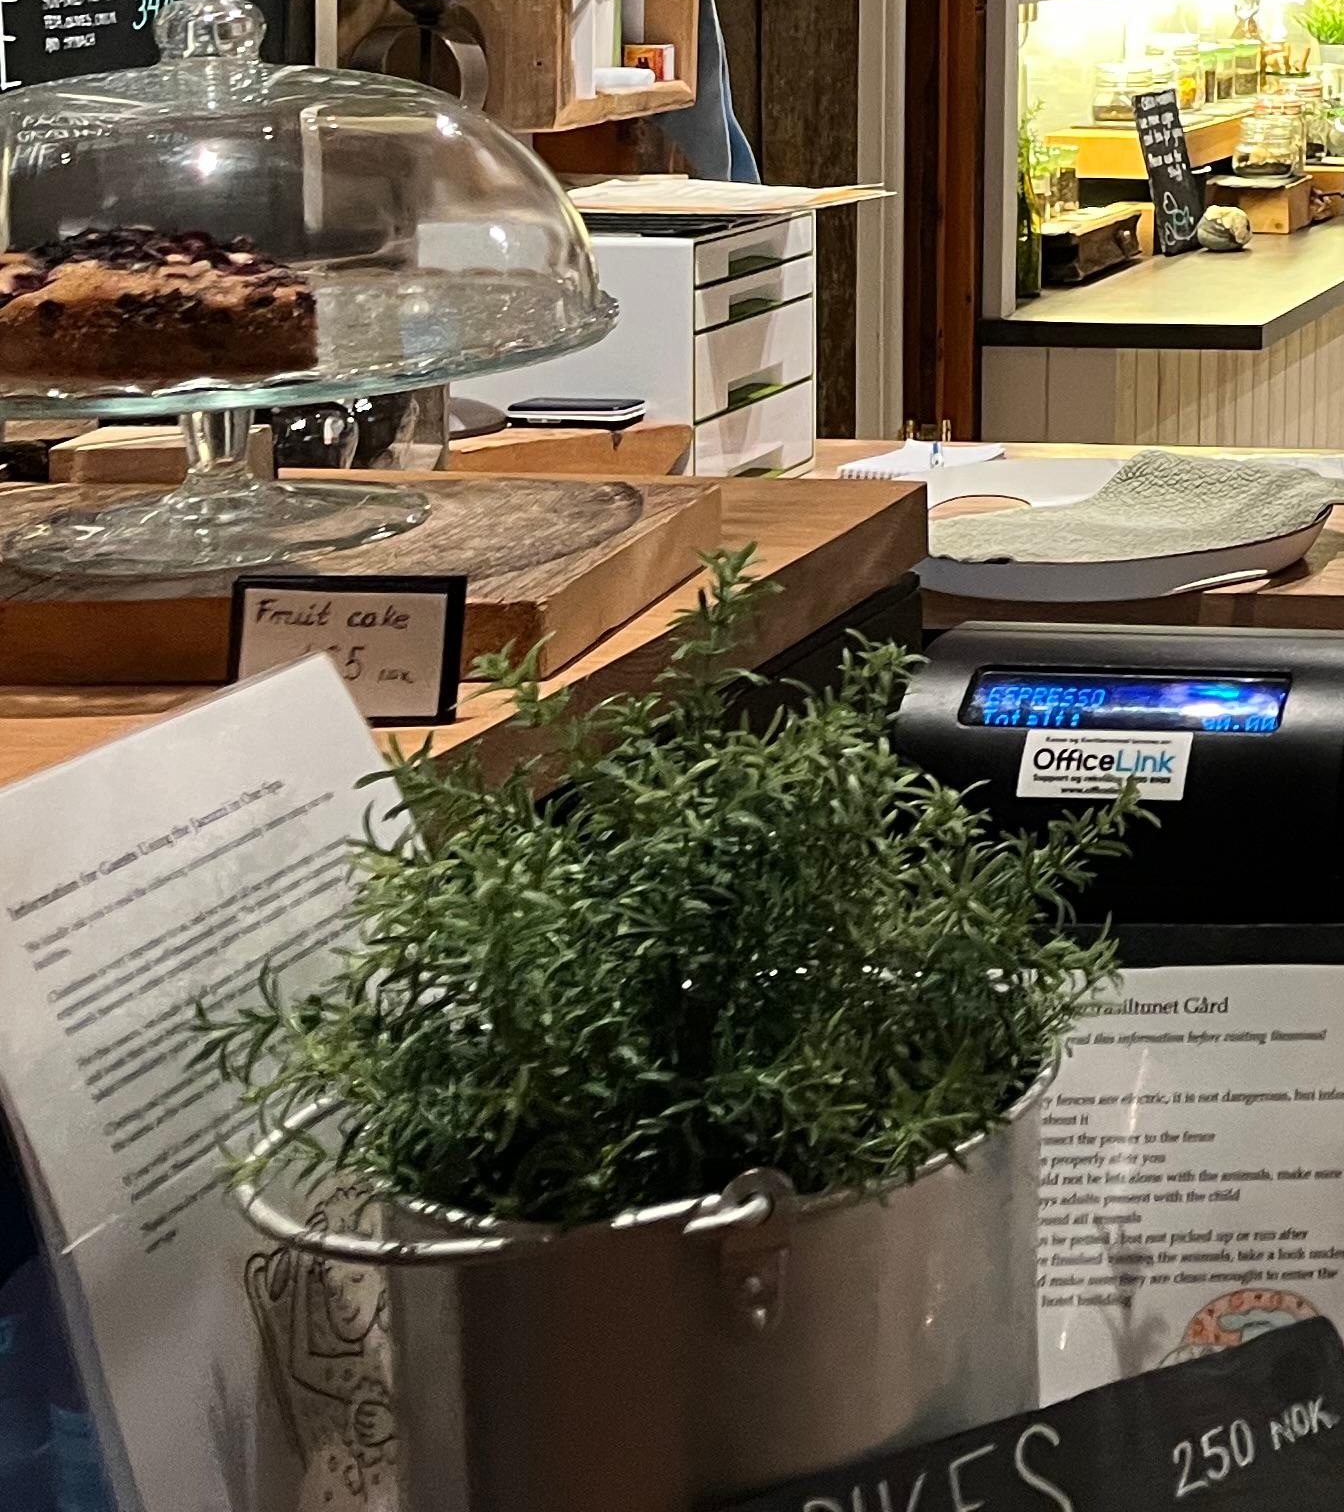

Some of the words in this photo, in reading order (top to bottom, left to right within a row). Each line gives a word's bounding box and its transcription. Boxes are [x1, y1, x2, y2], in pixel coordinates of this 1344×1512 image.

[256, 593, 332, 626] Fruit
[346, 600, 411, 630] cake
[986, 686, 1107, 709] ESPRESSO
[1033, 748, 1177, 774] OfficeLink
[1183, 996, 1229, 1015] Gård
[1172, 1420, 1254, 1498] 250
[1269, 1397, 1340, 1451] NOK
